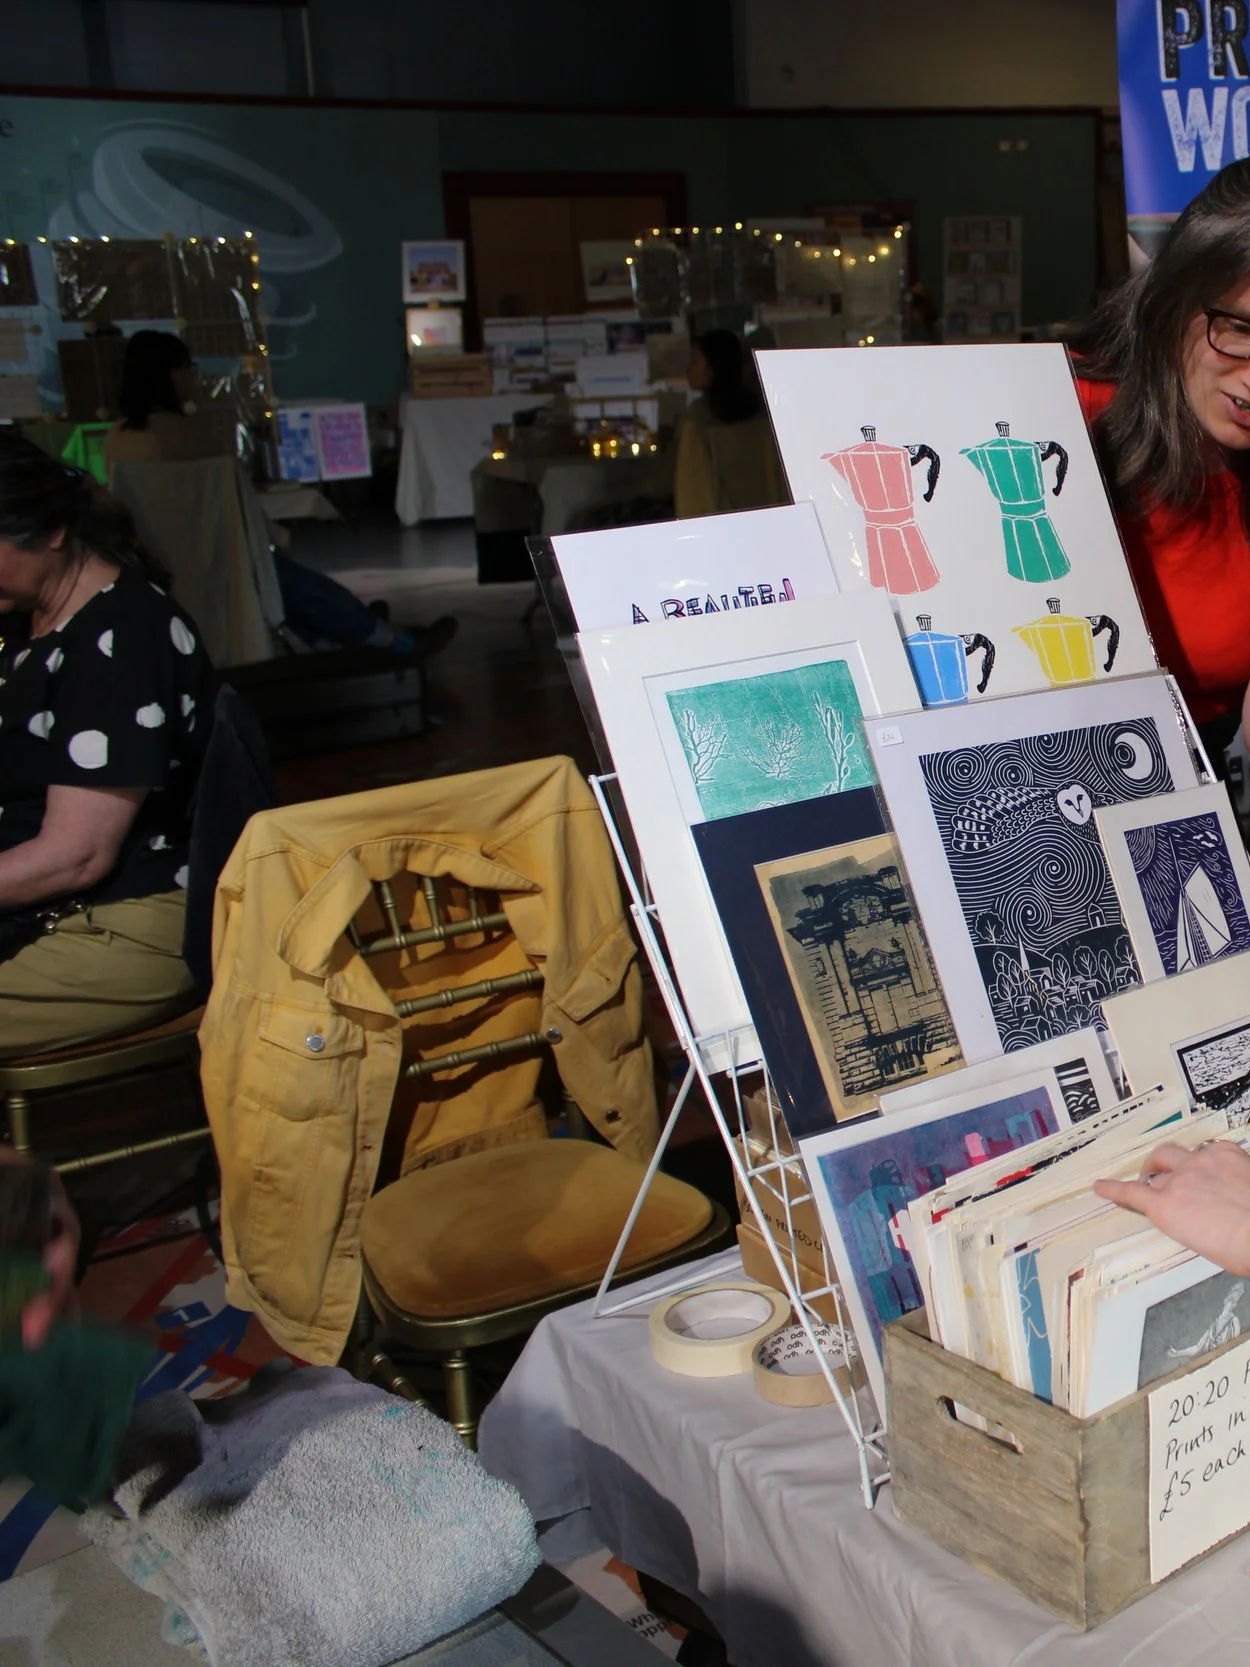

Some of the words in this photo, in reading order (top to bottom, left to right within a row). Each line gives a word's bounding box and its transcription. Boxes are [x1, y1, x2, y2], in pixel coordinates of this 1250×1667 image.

[1168, 1375, 1230, 1429] 20:20
[1165, 1424, 1214, 1470] Prints
[1228, 1403, 1247, 1431] in
[1159, 1470, 1195, 1522] £5
[1202, 1440, 1247, 1482] each
